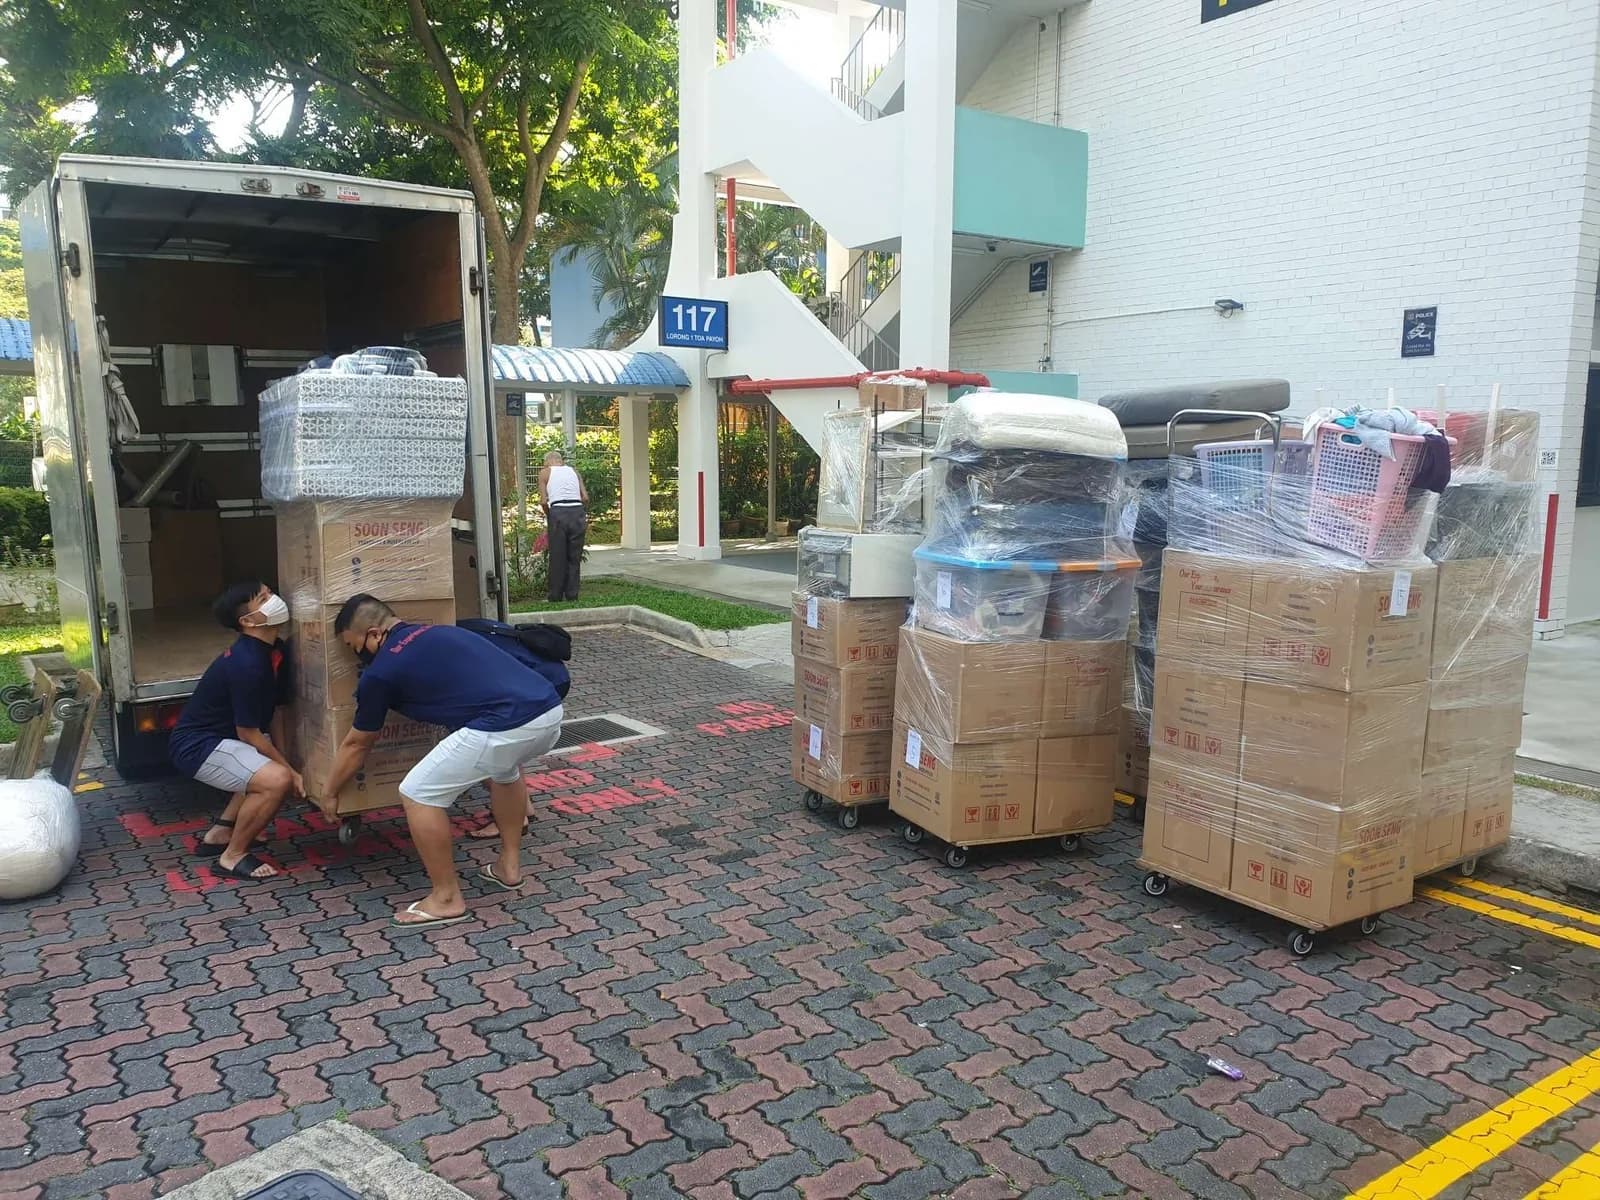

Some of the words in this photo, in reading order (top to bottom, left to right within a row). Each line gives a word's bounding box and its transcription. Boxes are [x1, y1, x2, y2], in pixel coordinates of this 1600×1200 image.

[672, 304, 717, 332] 117
[666, 333, 690, 341] LORONG
[354, 522, 388, 537] SOON
[392, 521, 424, 536] SENG
[696, 708, 796, 737] PARK
[523, 768, 594, 793] ND
